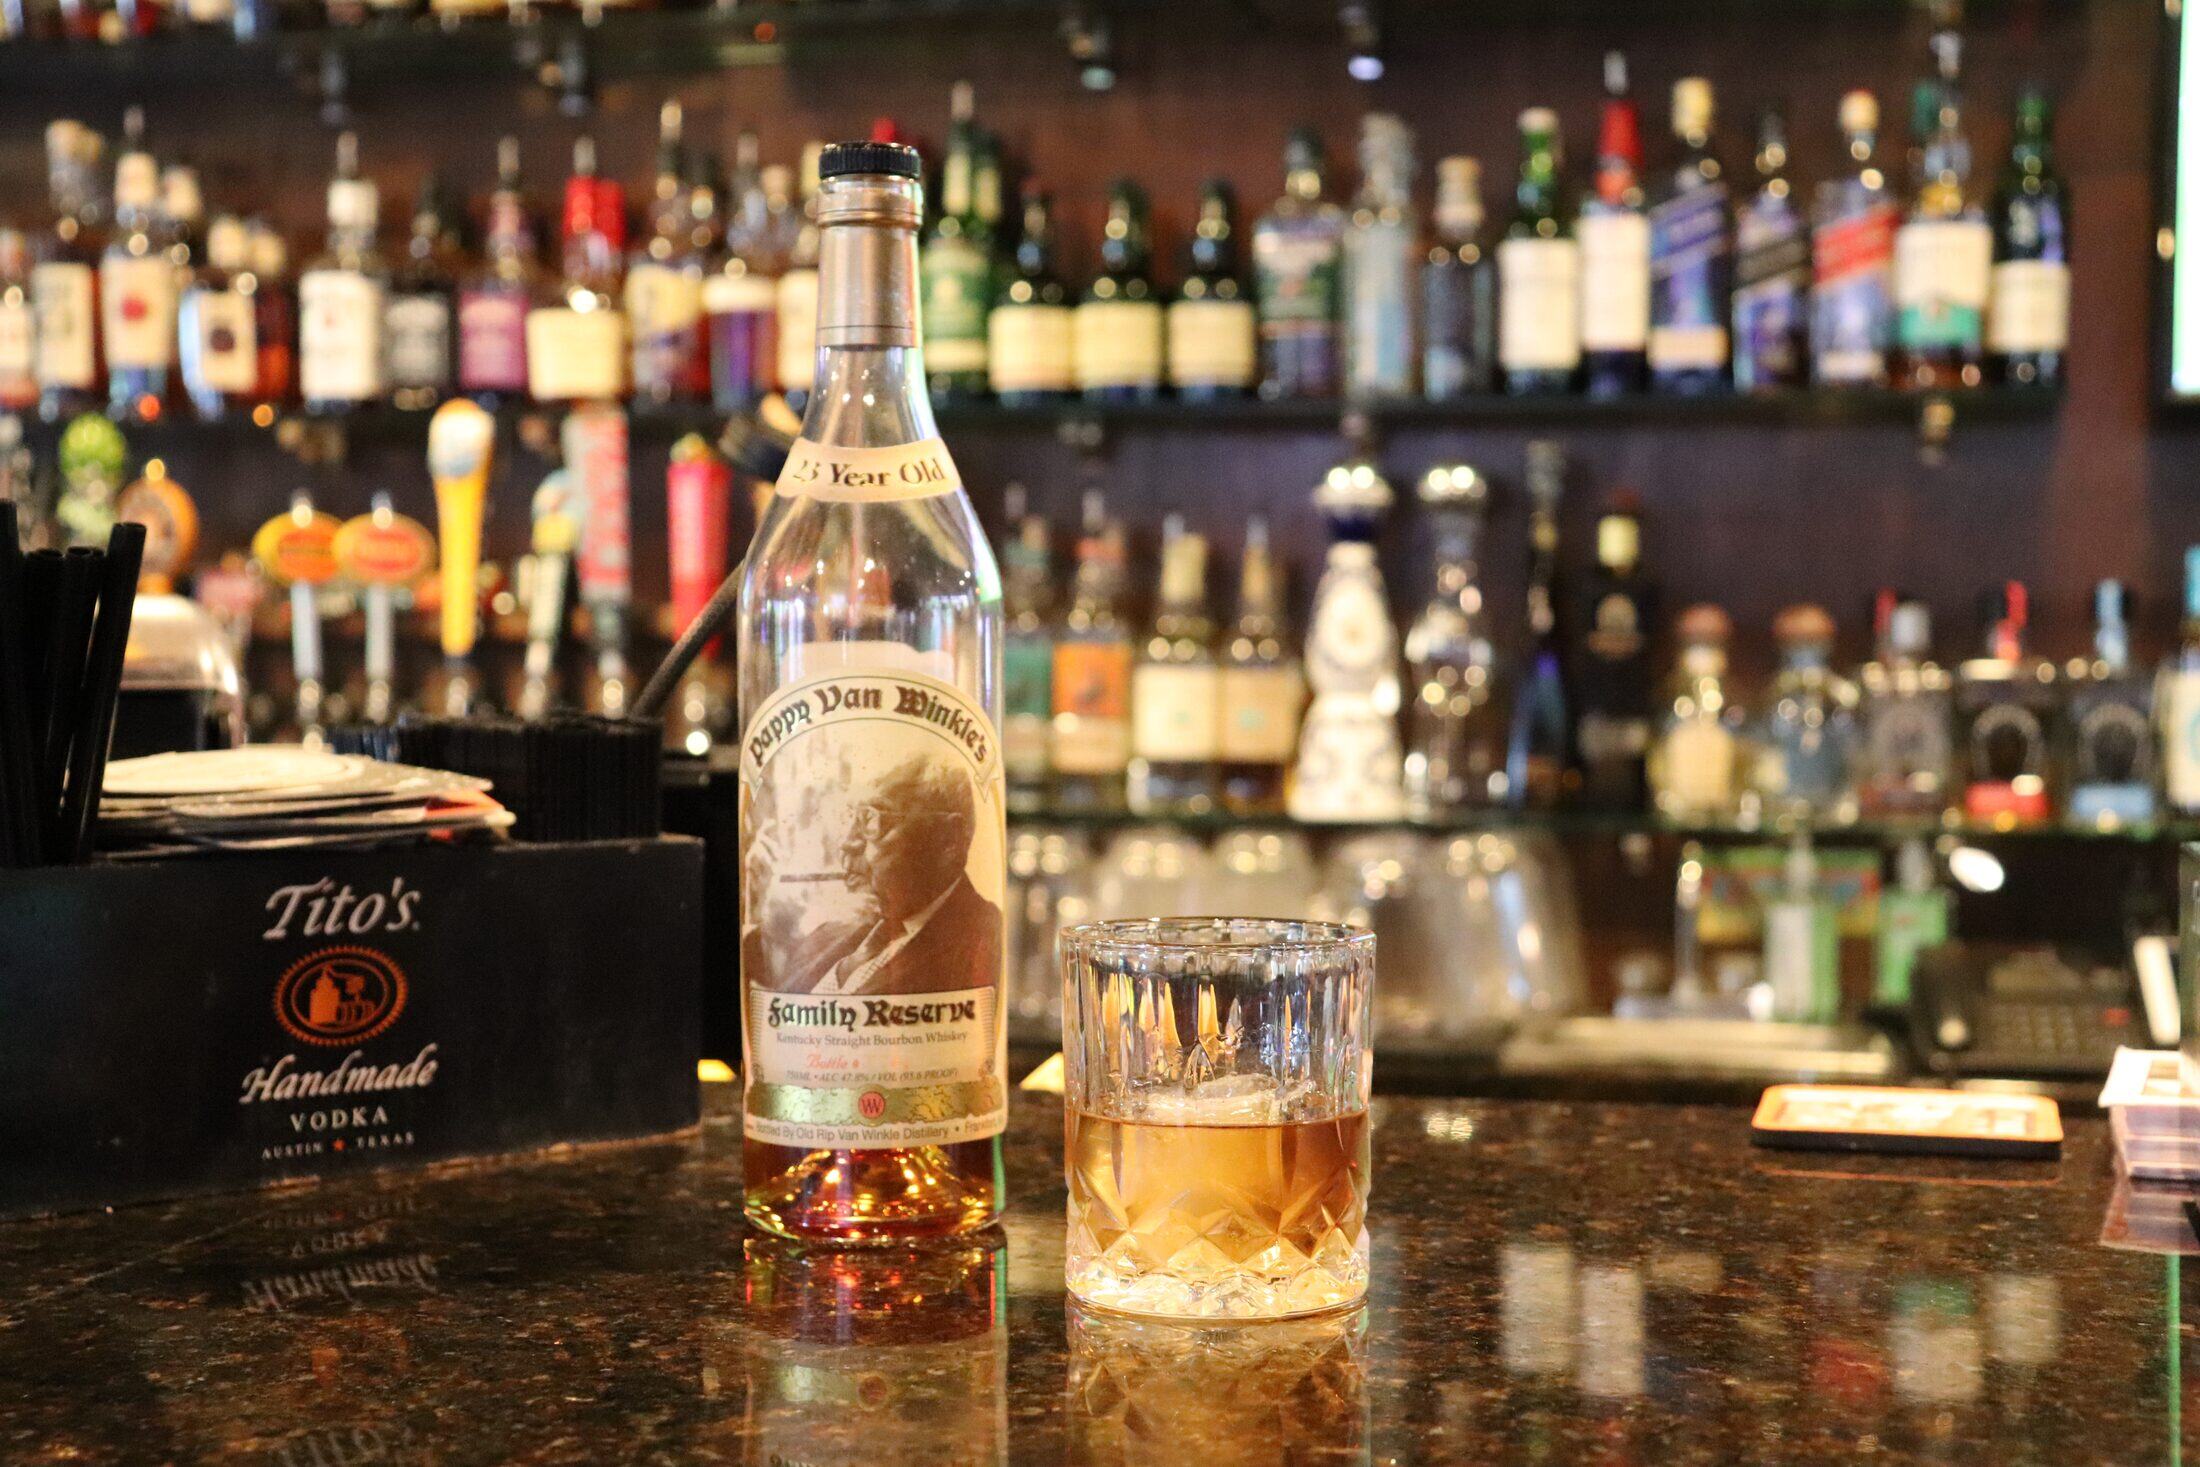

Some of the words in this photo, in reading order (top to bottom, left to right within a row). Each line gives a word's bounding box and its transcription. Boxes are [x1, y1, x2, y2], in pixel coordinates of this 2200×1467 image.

[793, 460, 820, 482] 23
[829, 462, 891, 487] Year
[900, 458, 946, 484] Old
[749, 699, 812, 767] Pappy
[813, 685, 882, 715] Van
[893, 685, 988, 762] Winkle's
[262, 876, 421, 940] Tito's
[768, 997, 857, 1032] Family
[862, 998, 976, 1027] Reserve
[776, 1032, 822, 1047] Kentucky
[824, 1034, 871, 1048] Straight
[873, 1032, 923, 1046] Bourbon
[925, 1031, 967, 1045] Whiskey
[239, 1043, 439, 1104] Handmade
[807, 1053, 849, 1069] Bottle
[290, 1105, 388, 1132] VODKA
[262, 1142, 324, 1160] AUSTIN
[356, 1131, 415, 1149] TEXAS
[783, 1126, 795, 1140] By
[796, 1126, 814, 1139] Old
[817, 1128, 835, 1141] Rip
[838, 1129, 859, 1140] Van
[862, 1128, 900, 1140] Winkle
[903, 1127, 949, 1139] Distillery
